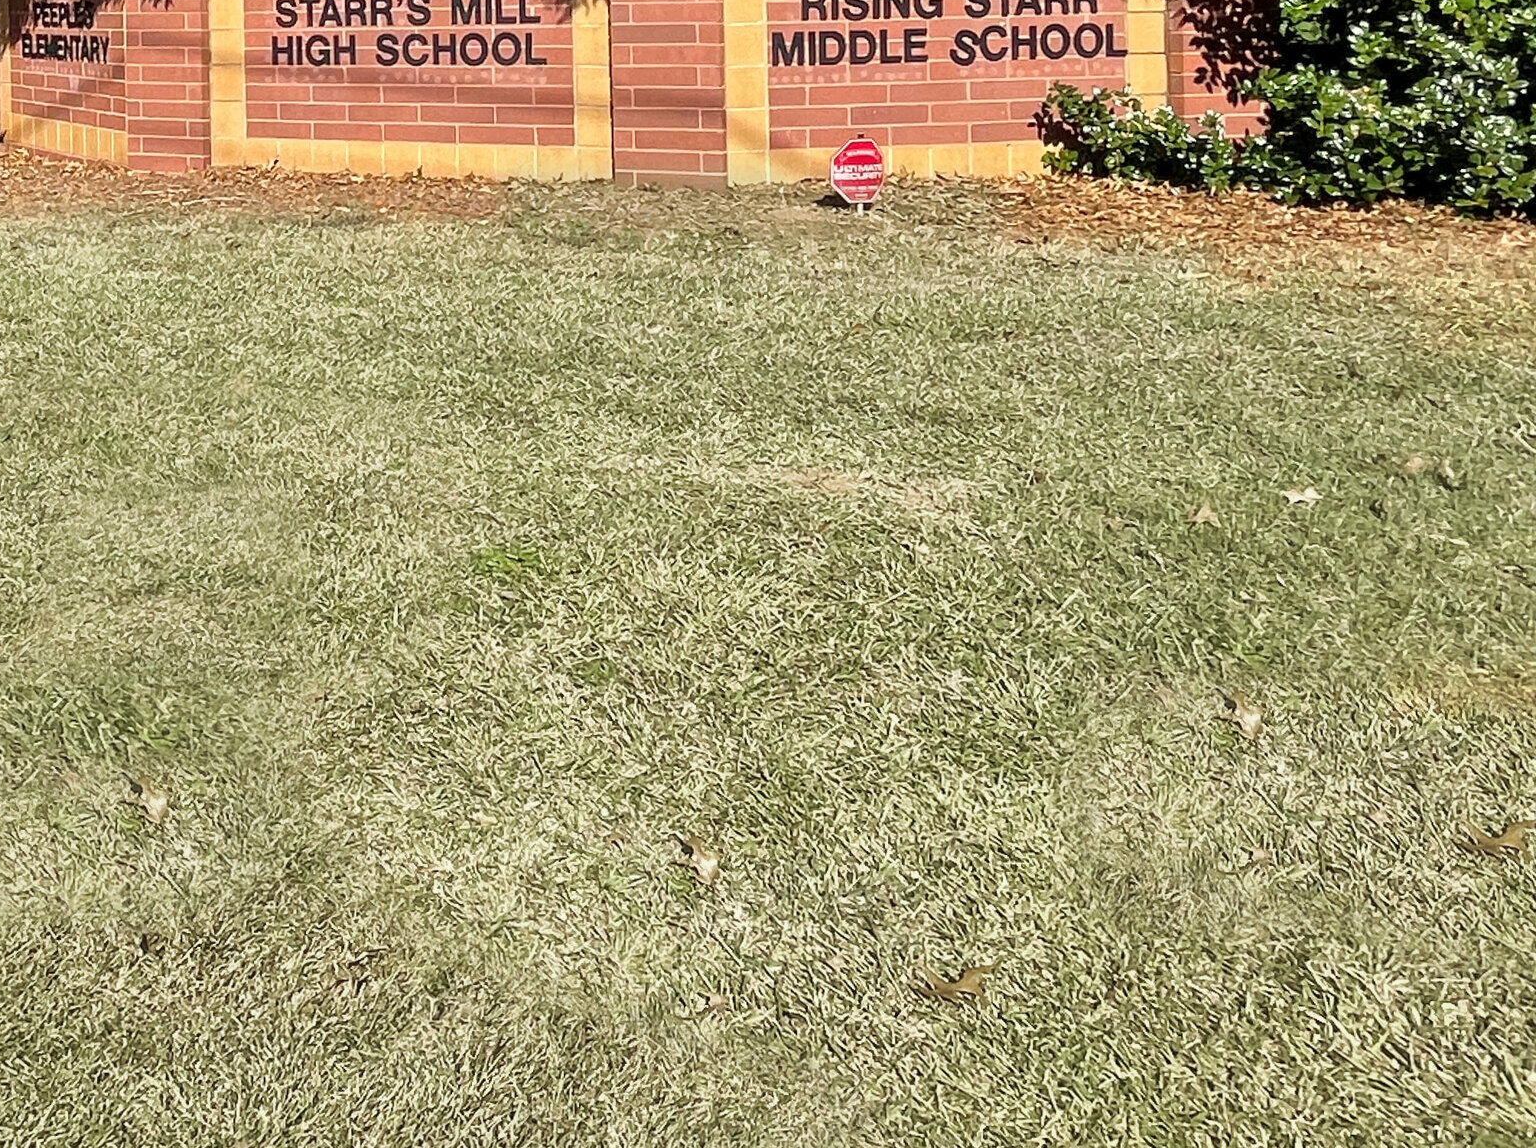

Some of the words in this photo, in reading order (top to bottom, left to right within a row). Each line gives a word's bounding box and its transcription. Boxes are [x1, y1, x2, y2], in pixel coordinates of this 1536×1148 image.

[21, 33, 110, 65] ELEMENTARY
[270, 35, 356, 67] HIGH
[375, 32, 547, 68] SCHOOL
[771, 28, 928, 67] MIDDLE
[949, 23, 1128, 67] SCHOOL
